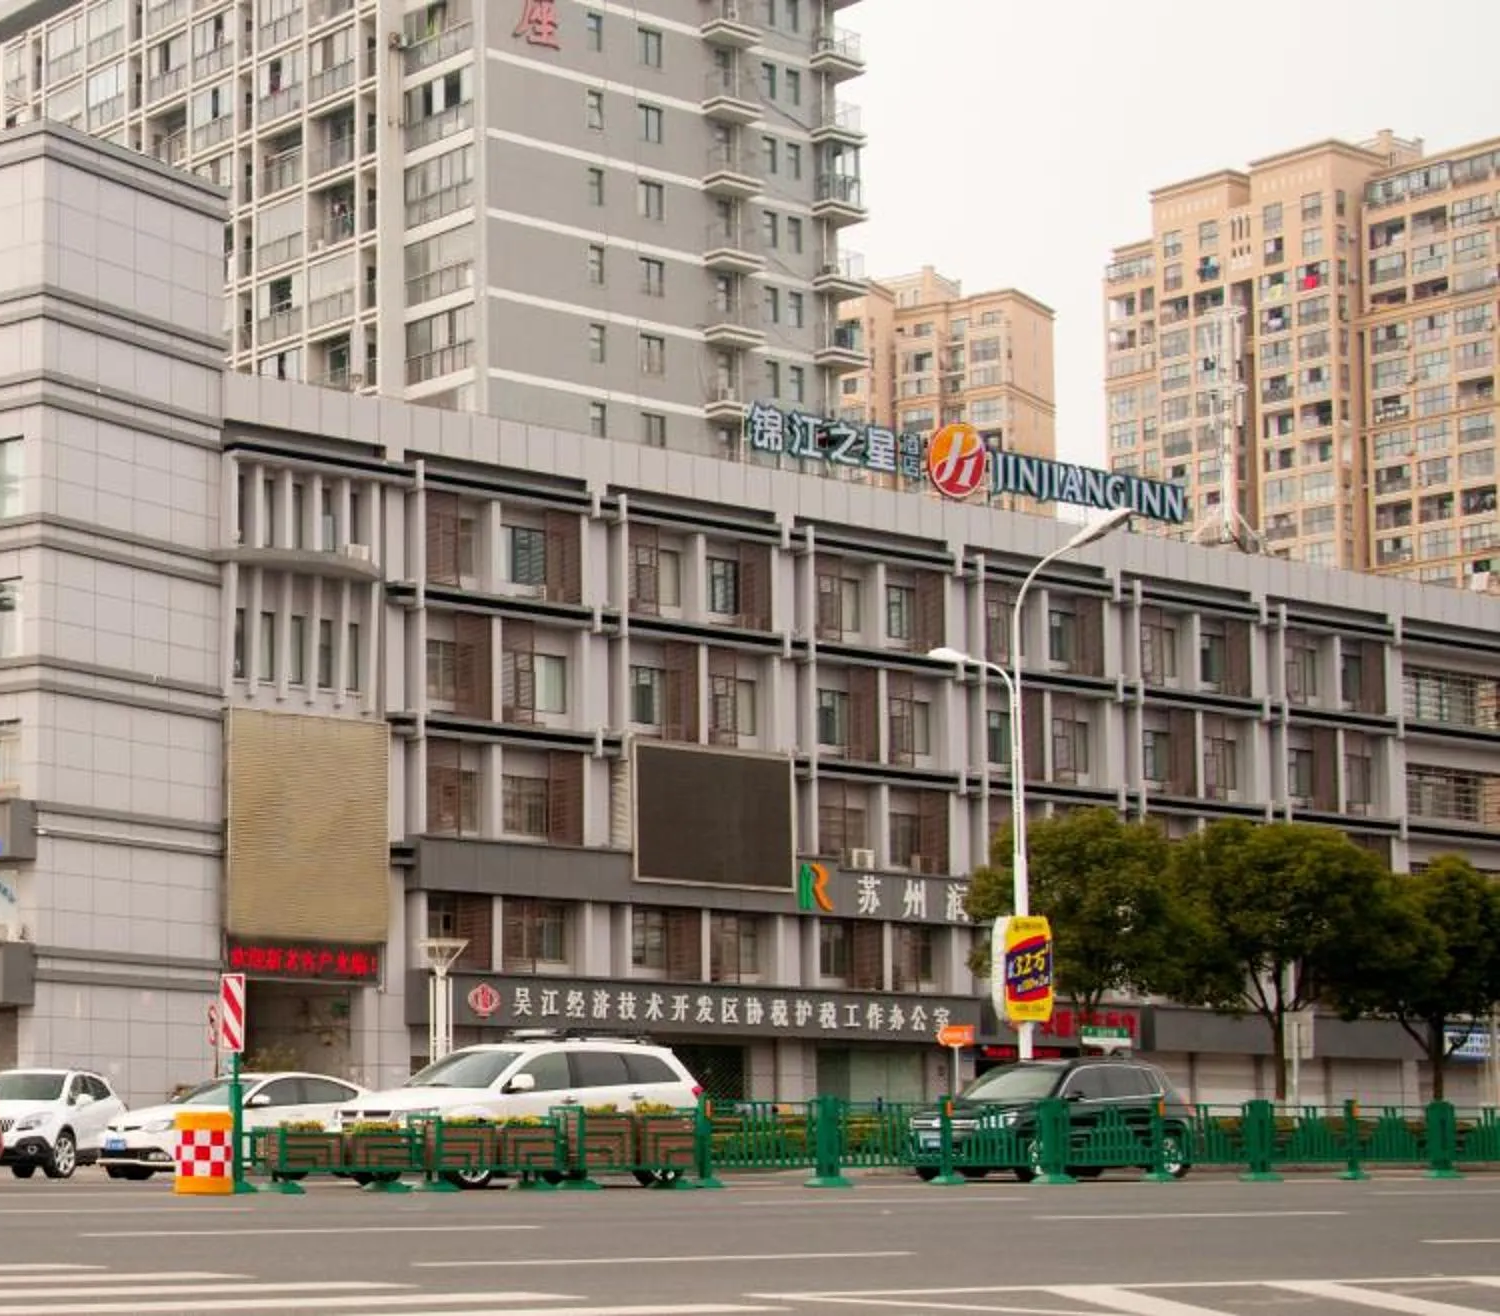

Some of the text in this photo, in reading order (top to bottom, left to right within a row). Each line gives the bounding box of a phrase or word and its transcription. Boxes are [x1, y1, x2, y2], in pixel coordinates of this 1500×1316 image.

[748, 403, 898, 474] 锦江之星
[899, 432, 922, 480] 酒店
[990, 450, 1188, 523] JINJIANG INN
[511, 986, 953, 1032] 吴江经济技术开发区协税护税工作办公室
